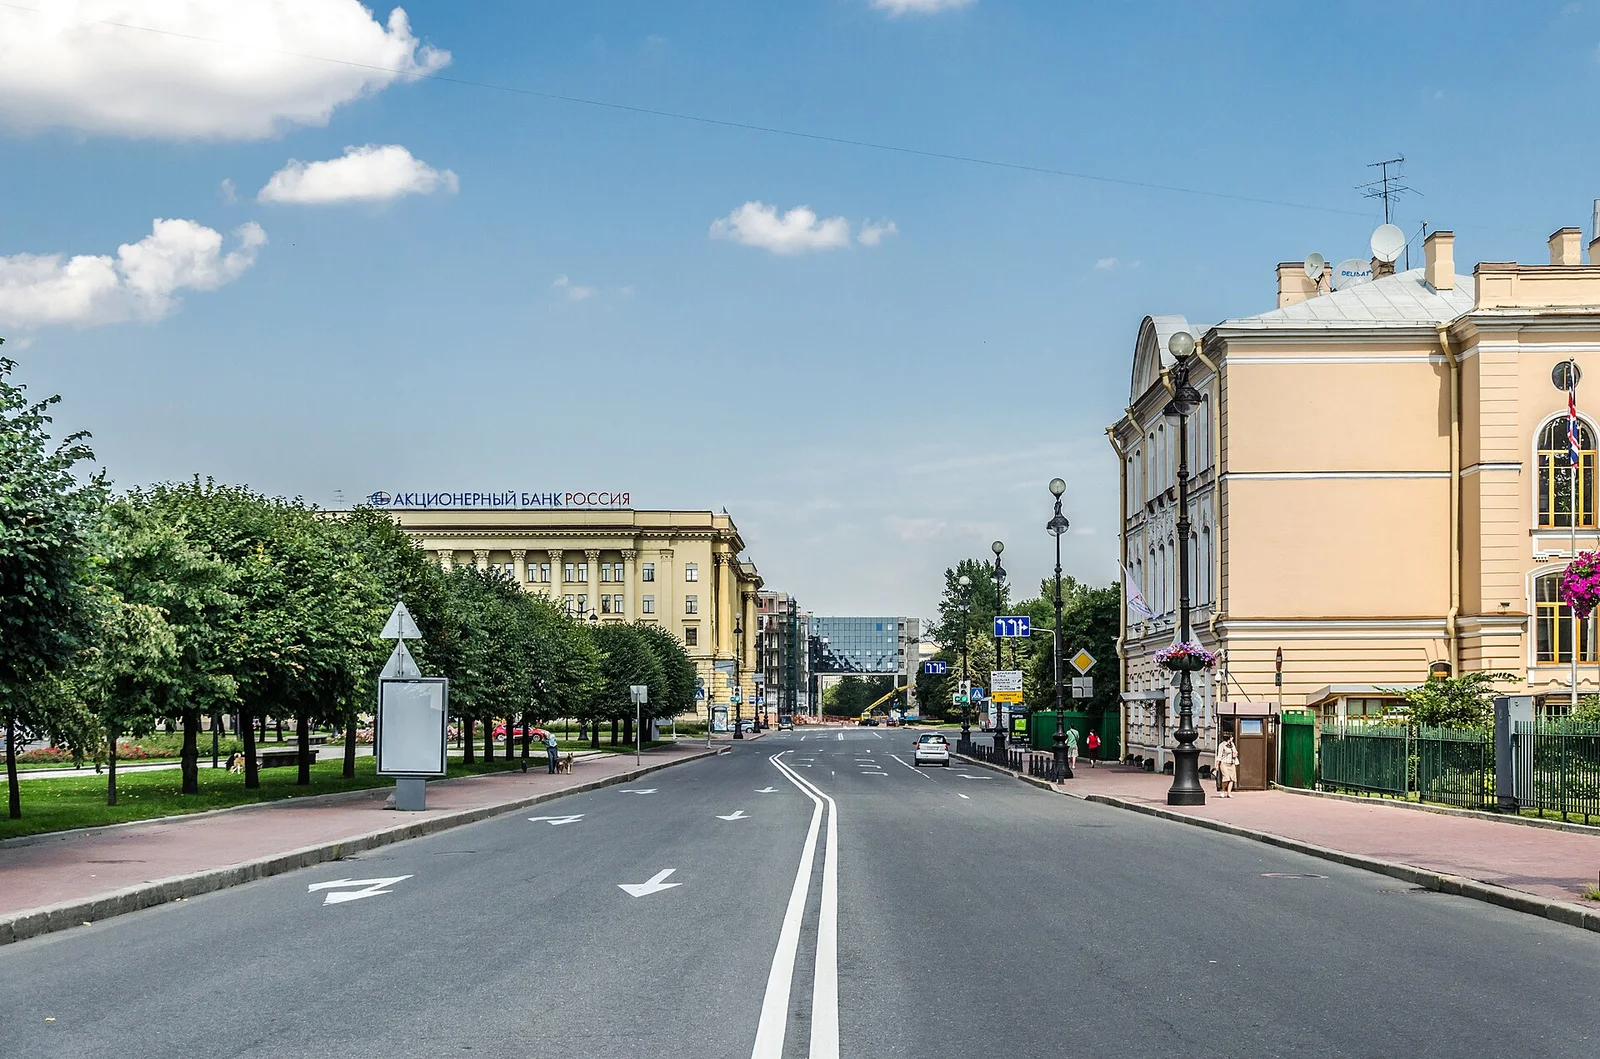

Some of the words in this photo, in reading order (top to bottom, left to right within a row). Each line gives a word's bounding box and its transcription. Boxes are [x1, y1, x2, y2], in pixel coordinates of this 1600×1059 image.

[393, 490, 517, 507] АКЦИОНЕРНЫЙ
[521, 492, 562, 506] БАНК
[565, 492, 630, 506] РОССИЯ
